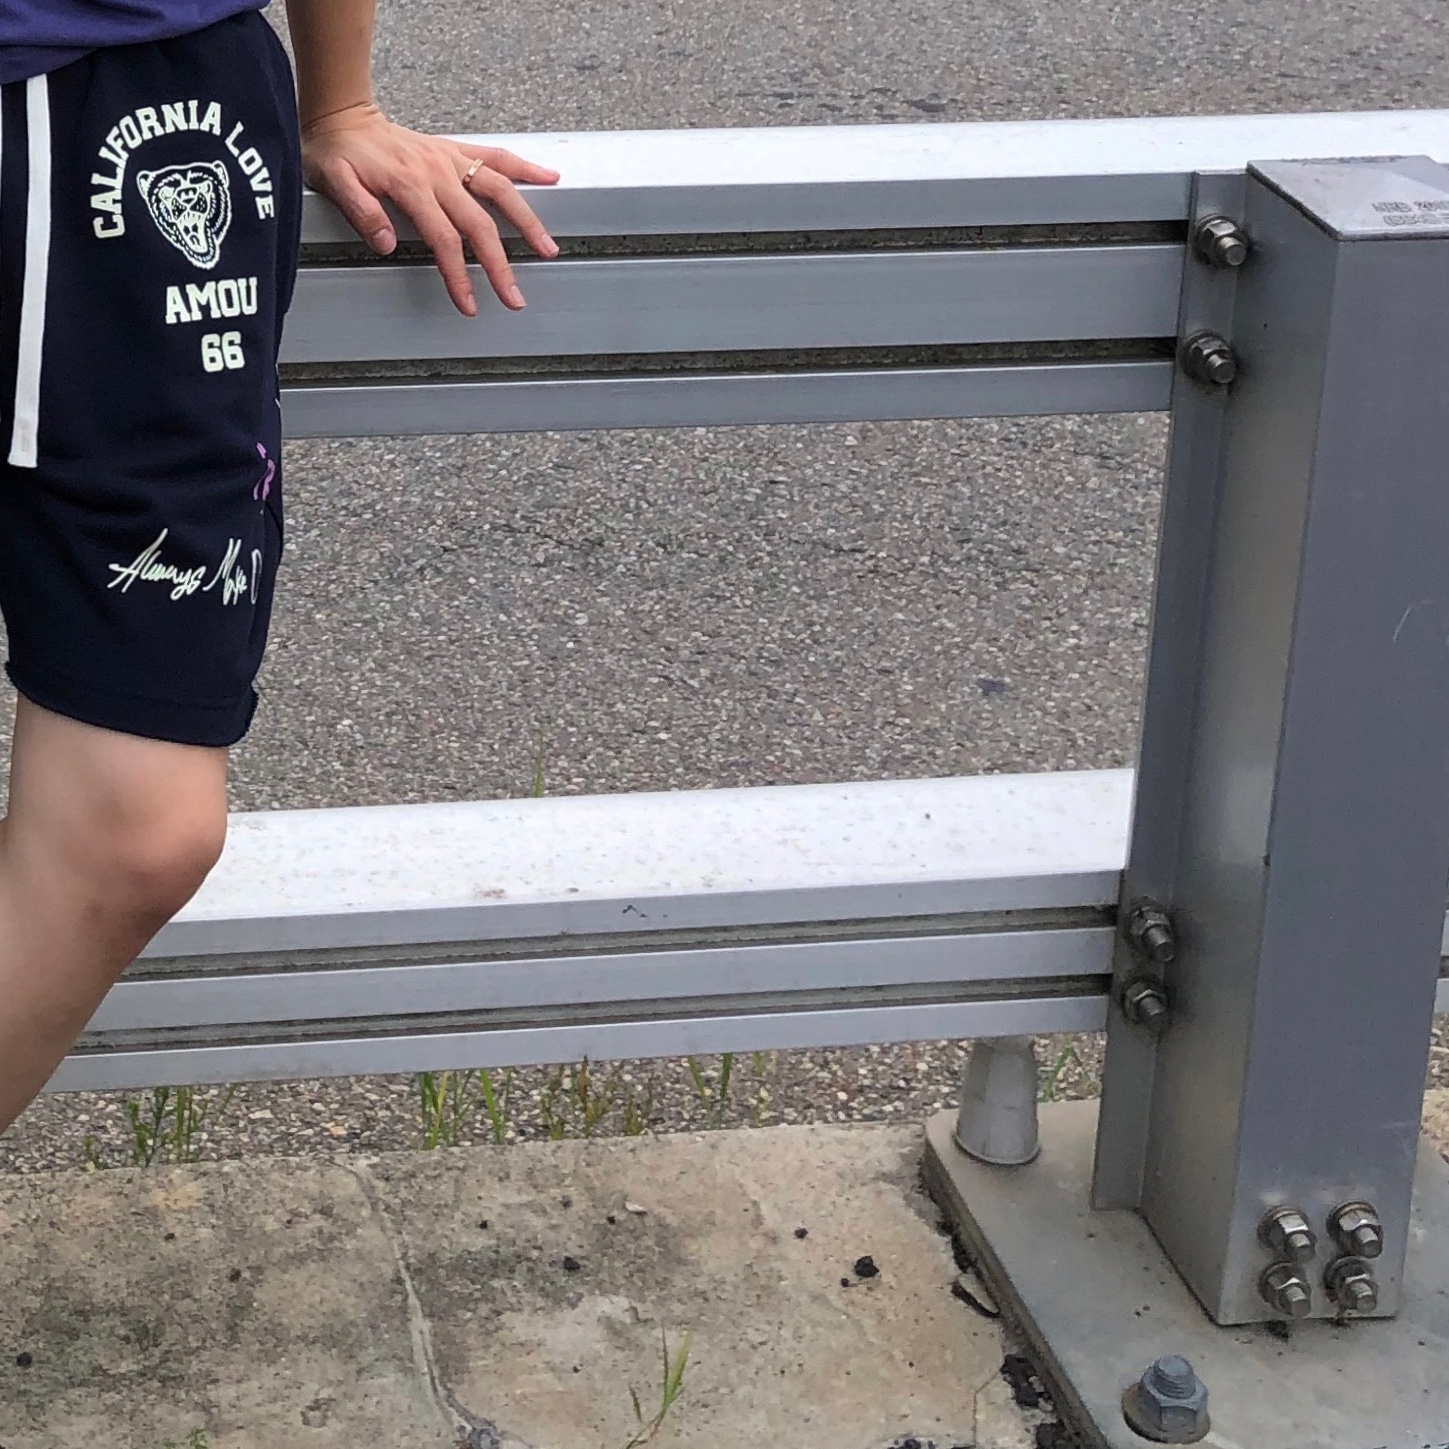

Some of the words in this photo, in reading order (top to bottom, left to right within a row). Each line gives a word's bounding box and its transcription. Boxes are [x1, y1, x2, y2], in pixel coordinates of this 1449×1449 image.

[90, 100, 223, 239] CALIFORNIA
[224, 120, 275, 220] LOVE
[165, 276, 258, 325] AMOU
[201, 330, 246, 373] 66
